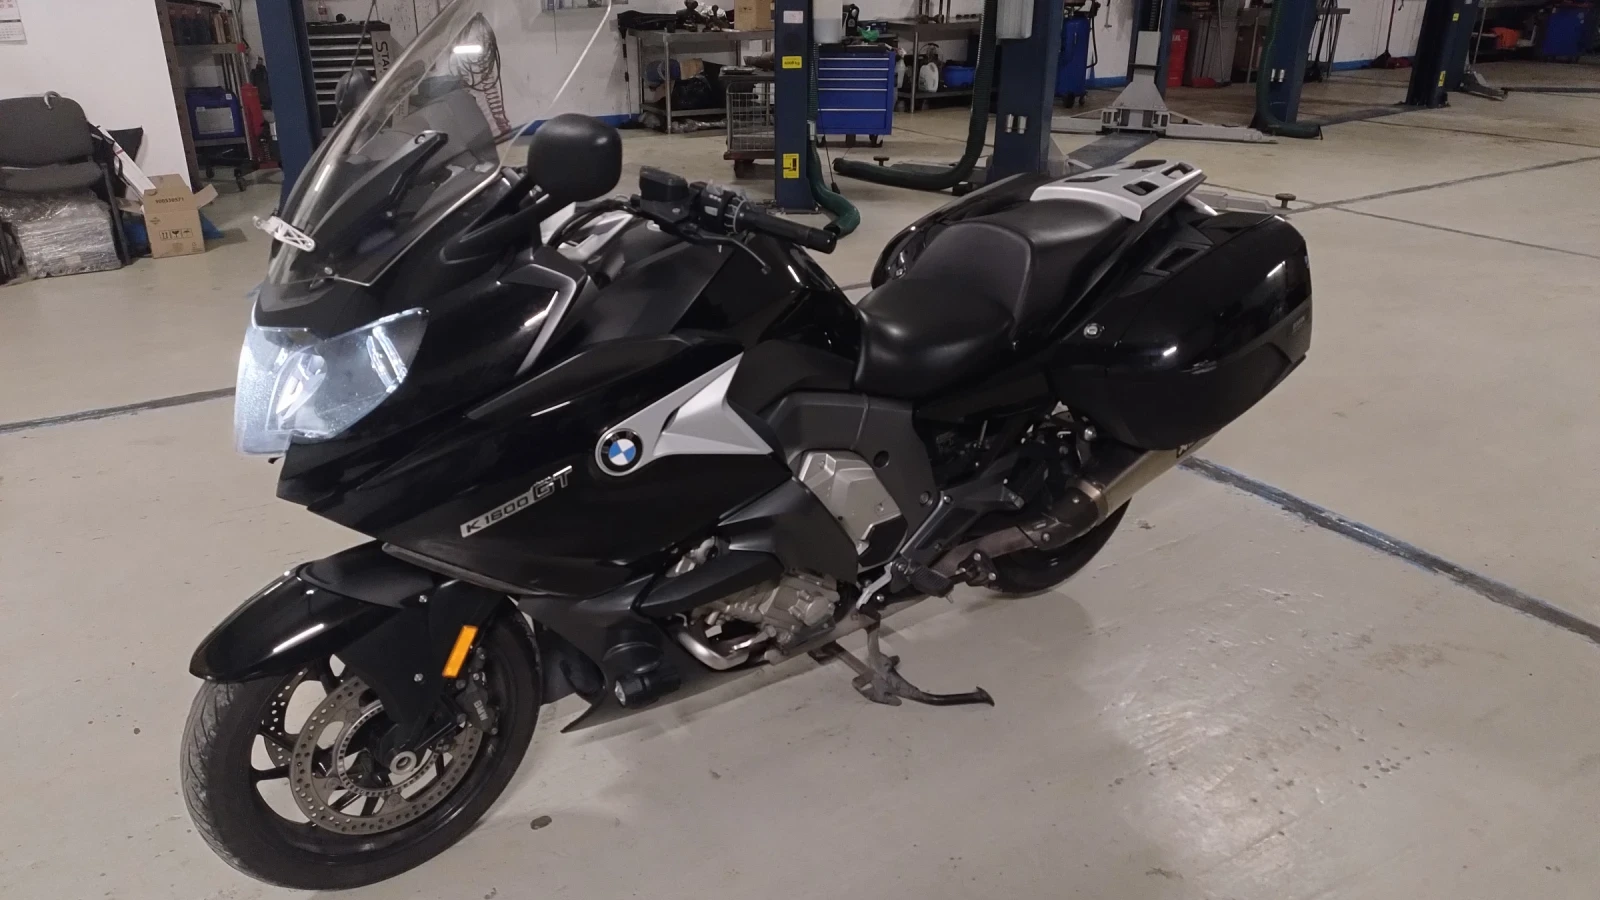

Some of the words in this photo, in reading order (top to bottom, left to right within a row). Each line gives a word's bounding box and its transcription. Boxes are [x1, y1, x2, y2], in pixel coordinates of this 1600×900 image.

[466, 519, 481, 533] K
[484, 496, 529, 525] 1600
[531, 465, 573, 501] GT
[473, 700, 488, 721] BMW
